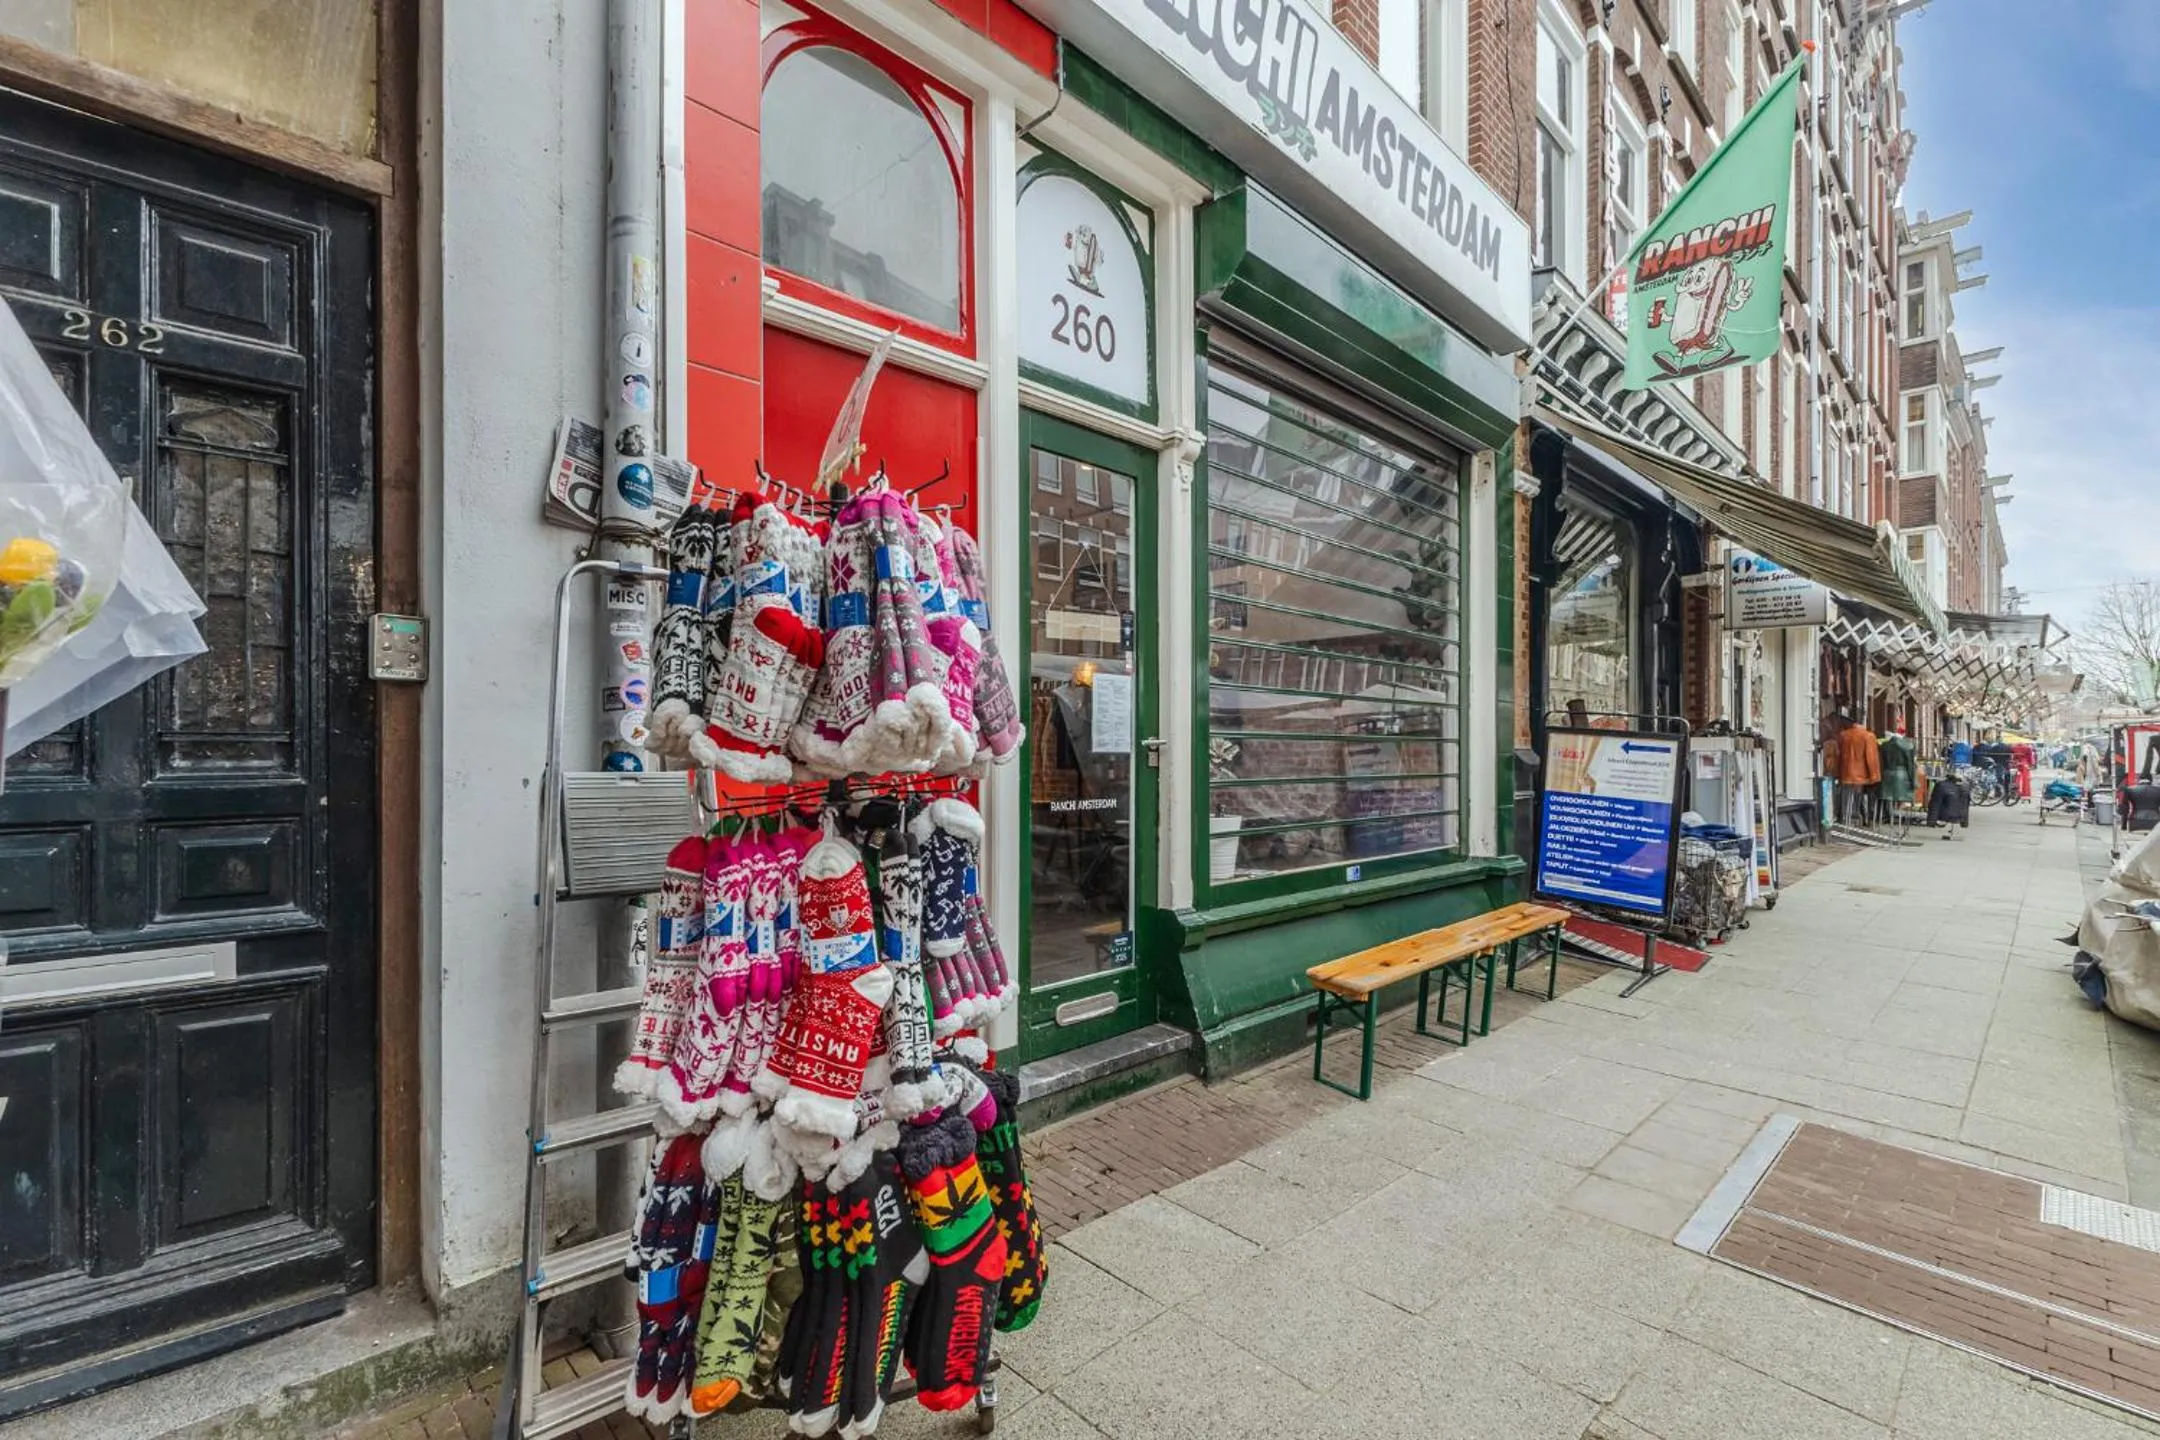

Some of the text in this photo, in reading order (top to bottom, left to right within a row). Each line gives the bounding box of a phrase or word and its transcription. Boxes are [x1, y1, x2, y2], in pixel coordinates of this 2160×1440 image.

[1314, 67, 1502, 282] AMSTERDAM
[1634, 204, 1776, 285] RANCHI
[1634, 274, 1679, 294] AMSTERDAM
[61, 310, 165, 355] 262
[1050, 293, 1116, 363] 260
[608, 589, 645, 605] MISC
[1050, 798, 1117, 811] RANCHI AMSTERDAM
[944, 1285, 984, 1382] AMSTERDAM
